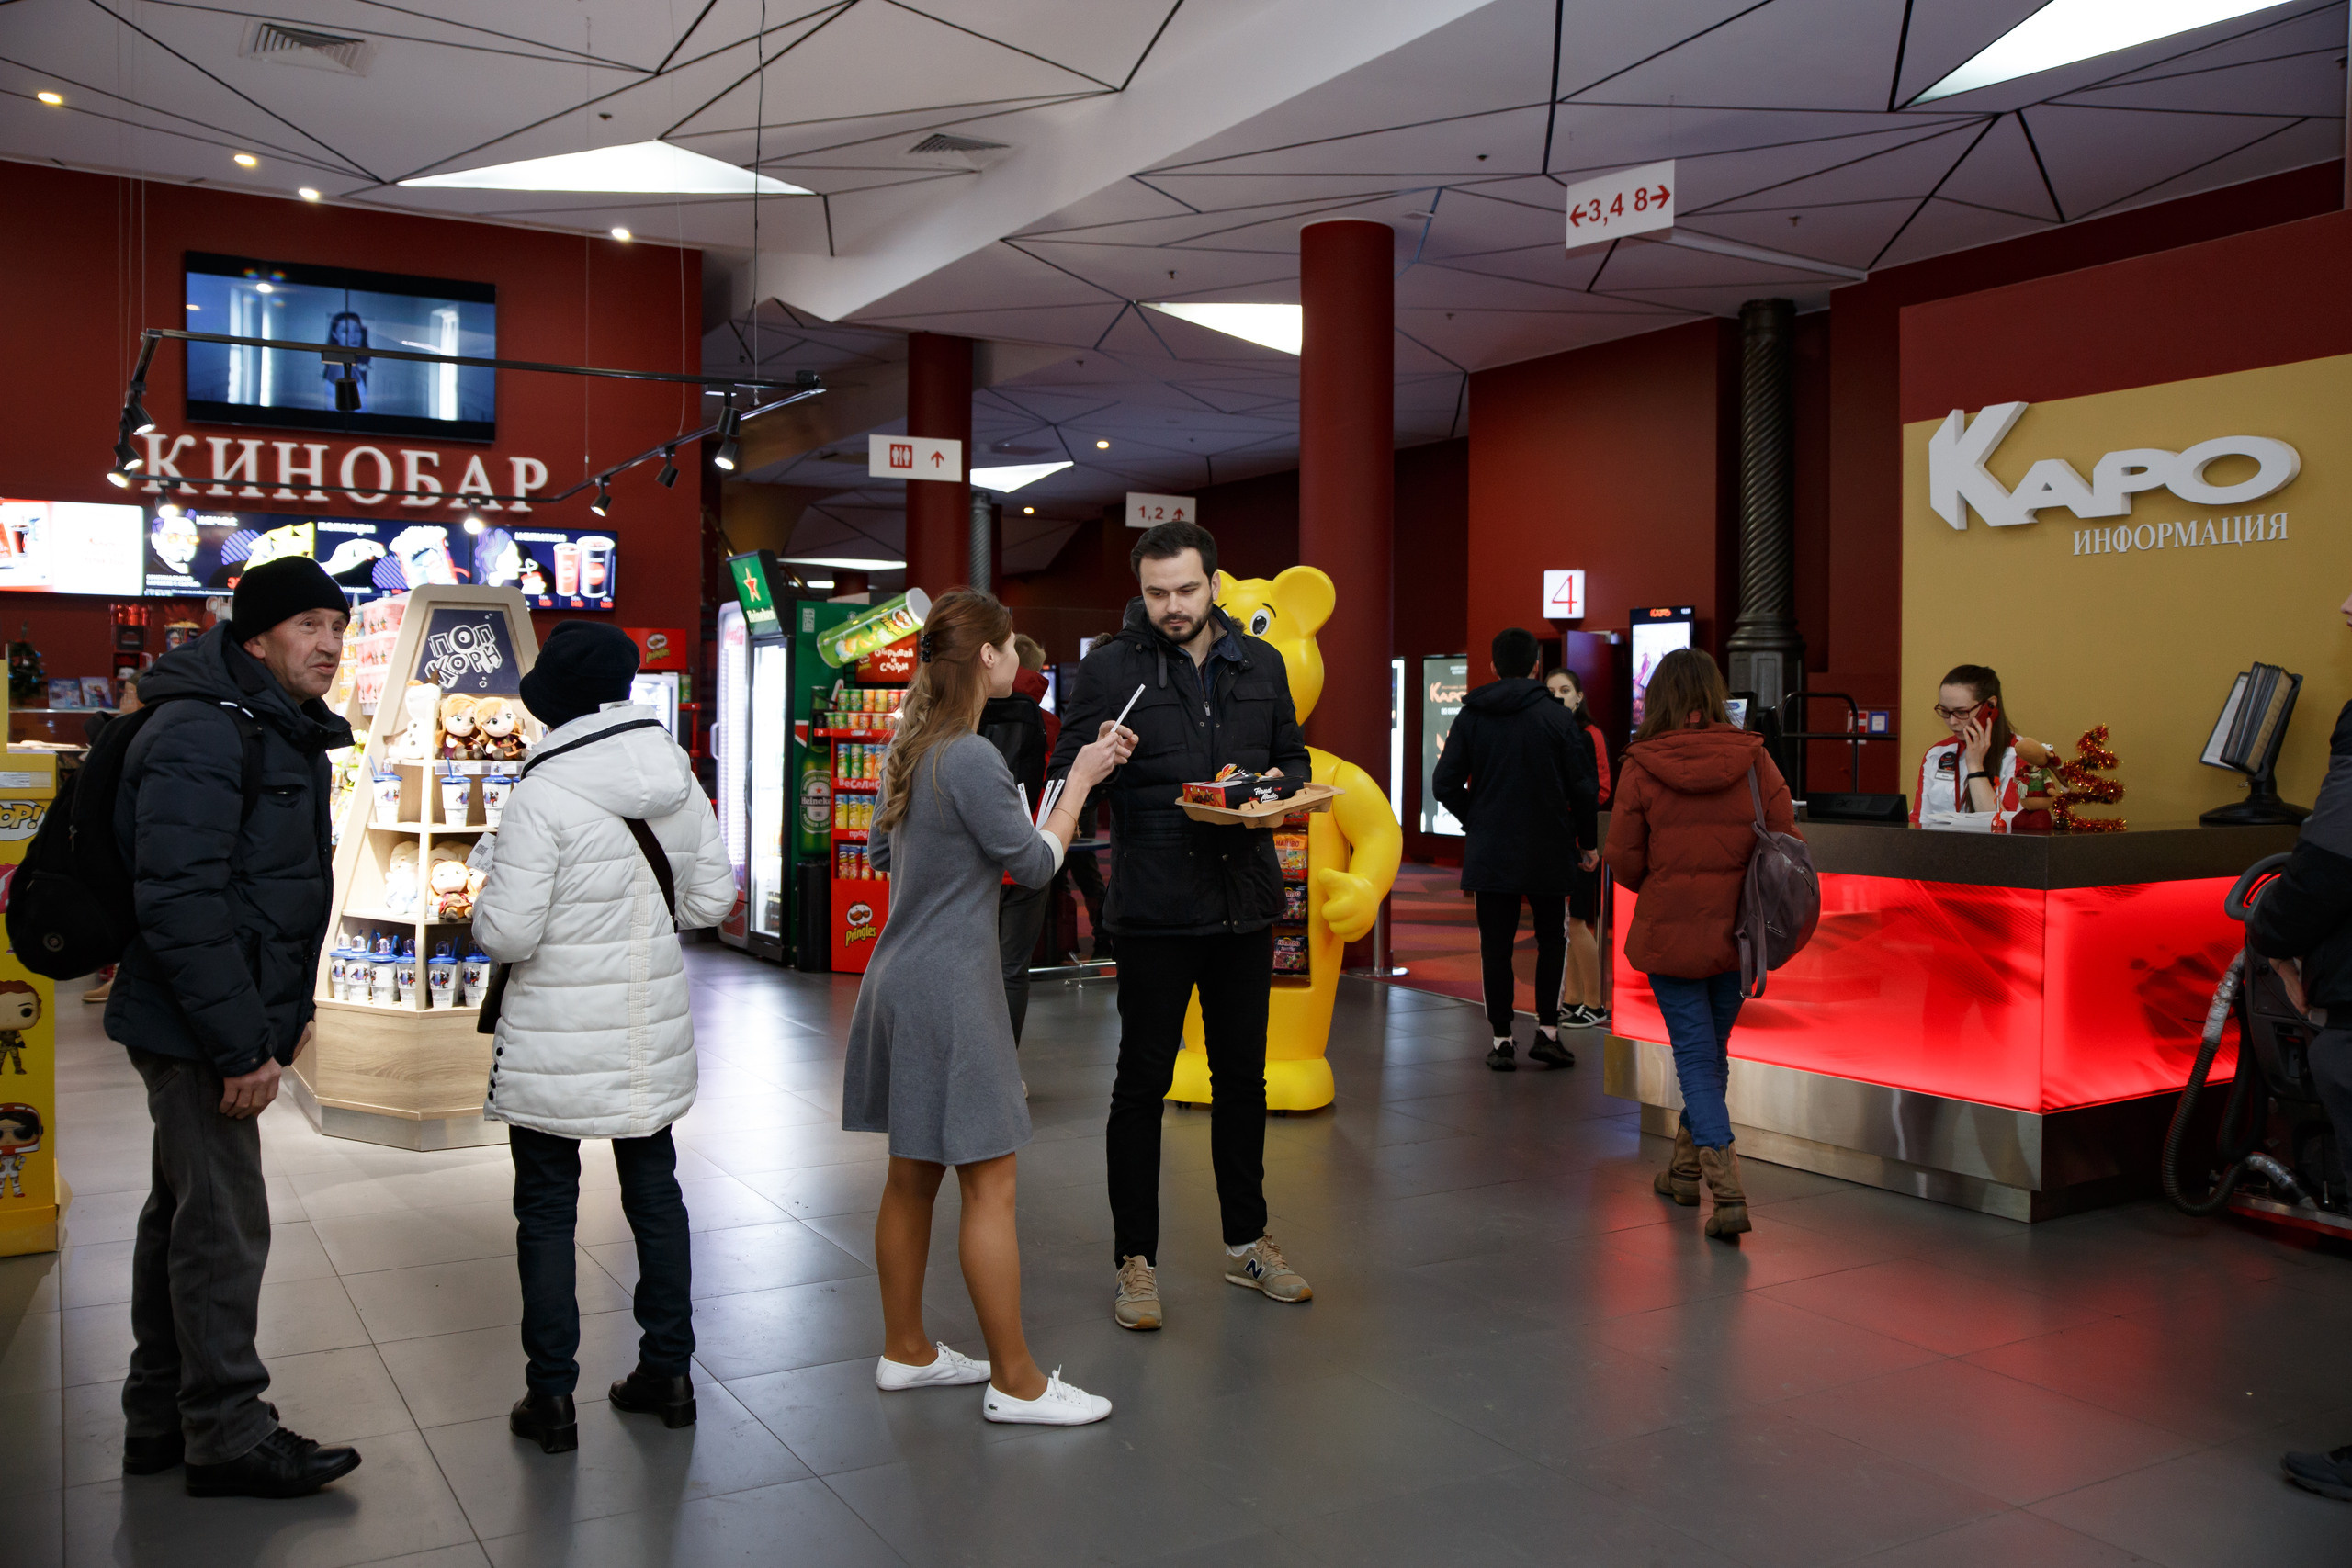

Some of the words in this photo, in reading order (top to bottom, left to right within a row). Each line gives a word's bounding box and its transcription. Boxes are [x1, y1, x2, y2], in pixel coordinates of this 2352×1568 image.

[1634, 187, 1648, 212] 8
[141, 433, 548, 513] КИНОБАР
[1928, 401, 2301, 531] КАРО
[2073, 512, 2290, 556] ИНФОРМАЦИЯ
[1551, 574, 1577, 615] 4
[801, 796, 831, 806] Heinek
[1254, 787, 1272, 795] Hand
[0, 803, 45, 831] OP!
[848, 829, 869, 839] проб
[845, 924, 876, 947] Pringles
